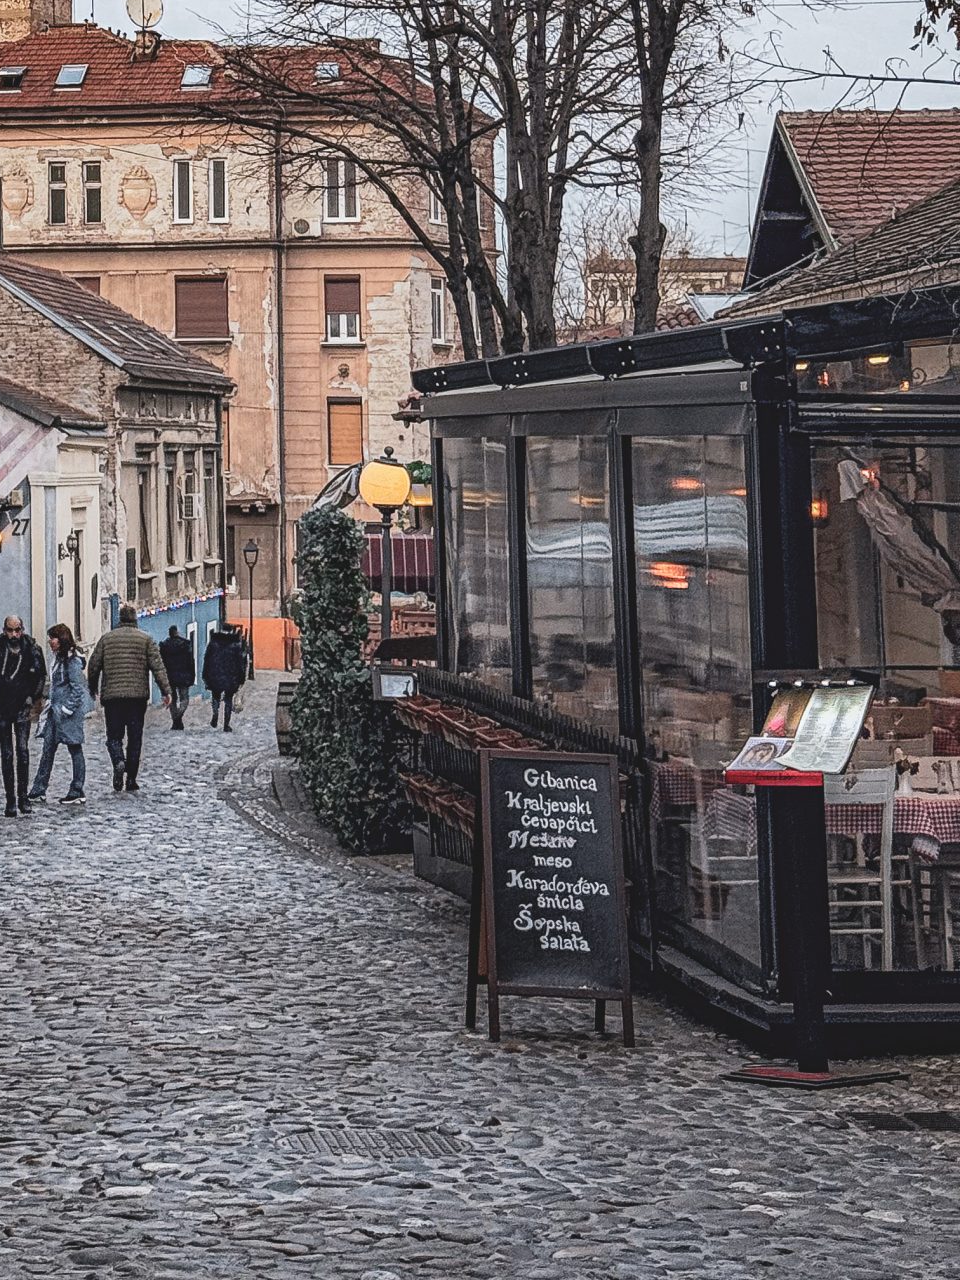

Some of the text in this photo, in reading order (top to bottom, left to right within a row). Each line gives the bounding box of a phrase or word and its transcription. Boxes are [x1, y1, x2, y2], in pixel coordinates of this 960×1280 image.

[11, 518, 30, 536] 27
[523, 768, 598, 792] Gibanica
[504, 790, 592, 817] Kraljevski
[532, 854, 573, 869] meso
[513, 903, 581, 937] Šopska
[539, 933, 591, 952] salata
